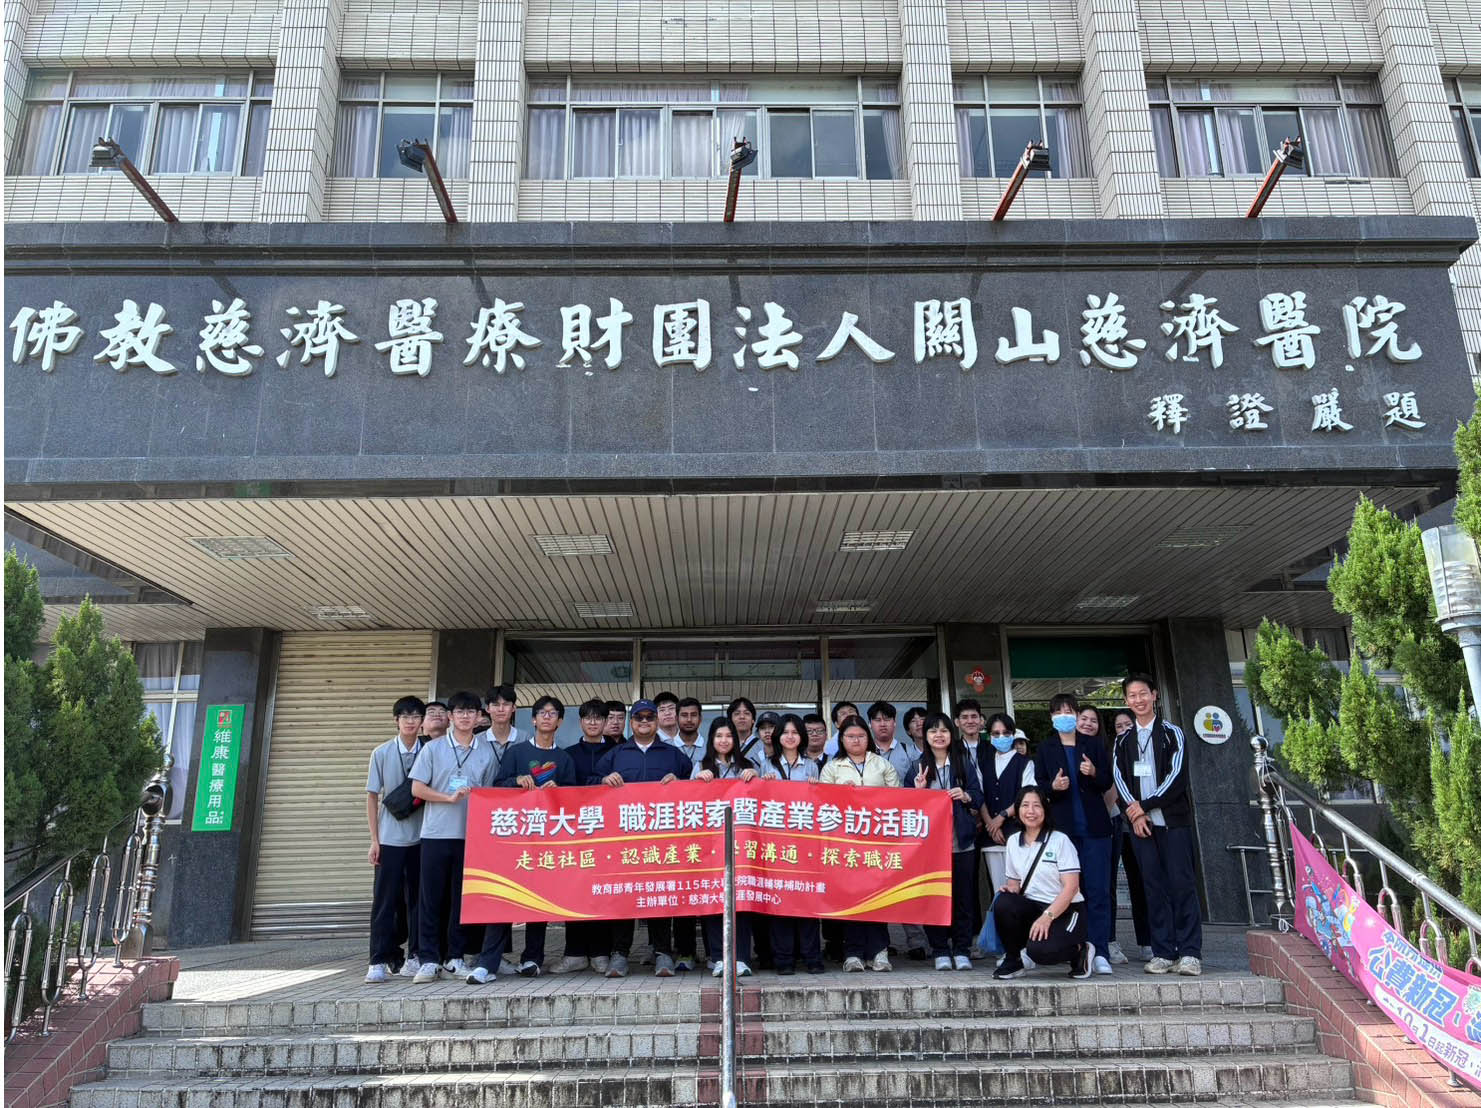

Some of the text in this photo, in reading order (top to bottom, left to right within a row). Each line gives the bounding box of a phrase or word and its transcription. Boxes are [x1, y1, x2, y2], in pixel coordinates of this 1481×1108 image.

[9, 289, 1423, 377] 佛教慈濟醫療財團法人關山慈濟醫院
[1148, 388, 1426, 434] 釋證嚴題
[205, 729, 231, 825] 維康醫療用品
[490, 797, 930, 838] 慈濟大學 職涯探索暨產業參訪活動
